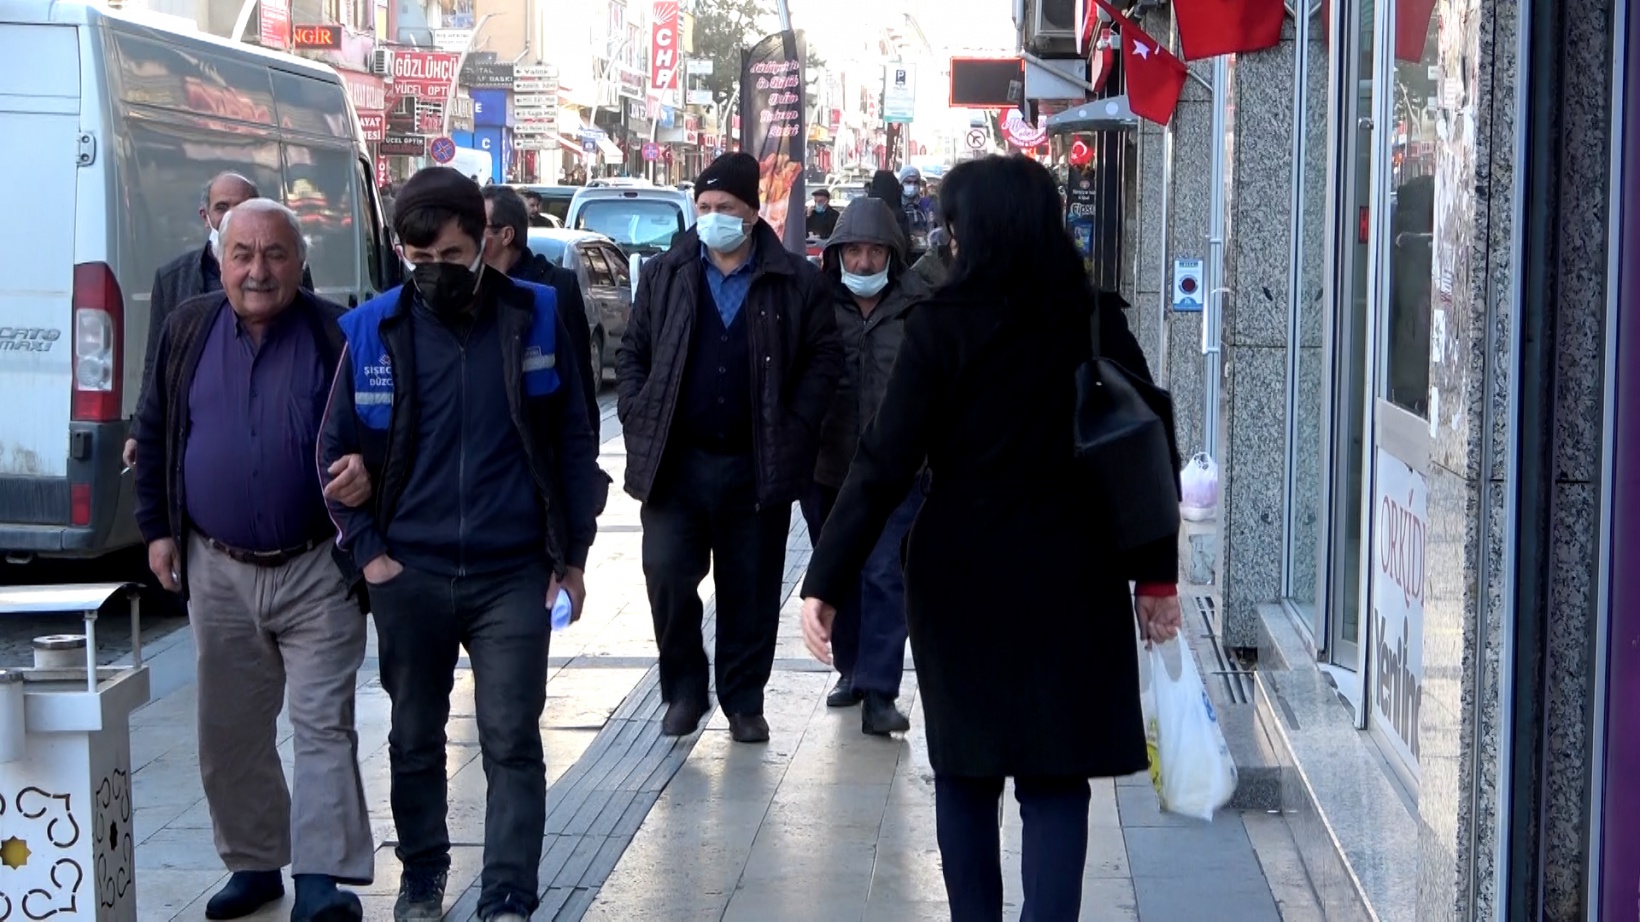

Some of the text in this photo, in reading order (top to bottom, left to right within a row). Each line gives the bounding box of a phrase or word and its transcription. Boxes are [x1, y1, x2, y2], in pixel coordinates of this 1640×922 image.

[395, 53, 458, 81] GÖZLÜKÇÜ
[655, 28, 673, 86] CHP
[1381, 488, 1425, 609] ORKİD
